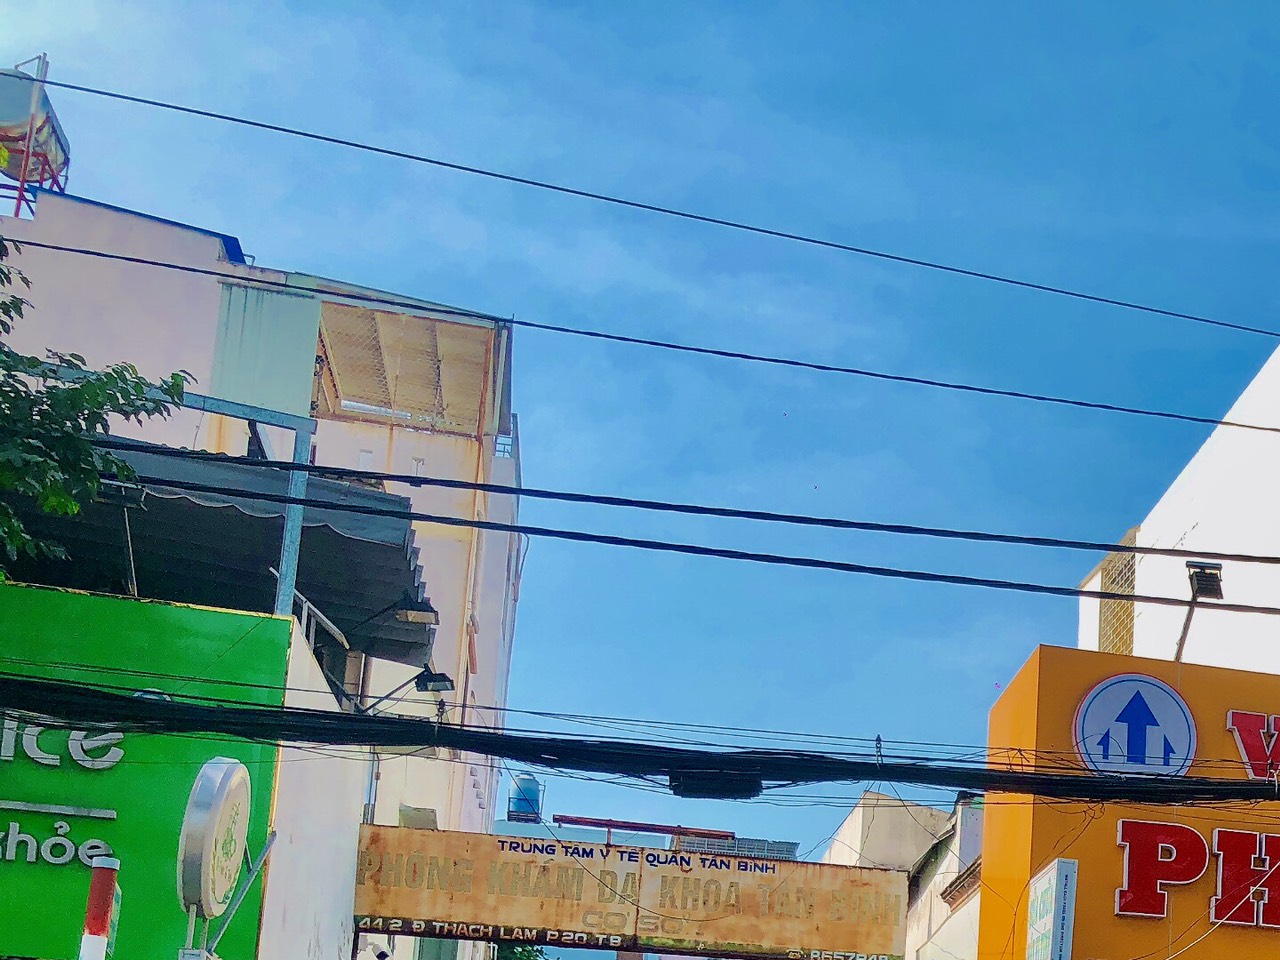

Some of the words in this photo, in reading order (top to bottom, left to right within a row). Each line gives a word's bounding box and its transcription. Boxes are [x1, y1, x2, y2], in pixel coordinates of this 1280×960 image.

[0, 821, 115, 867] hỏe
[498, 840, 556, 855] TRUNG
[660, 874, 741, 913] KHOA
[500, 927, 537, 940] LAM
